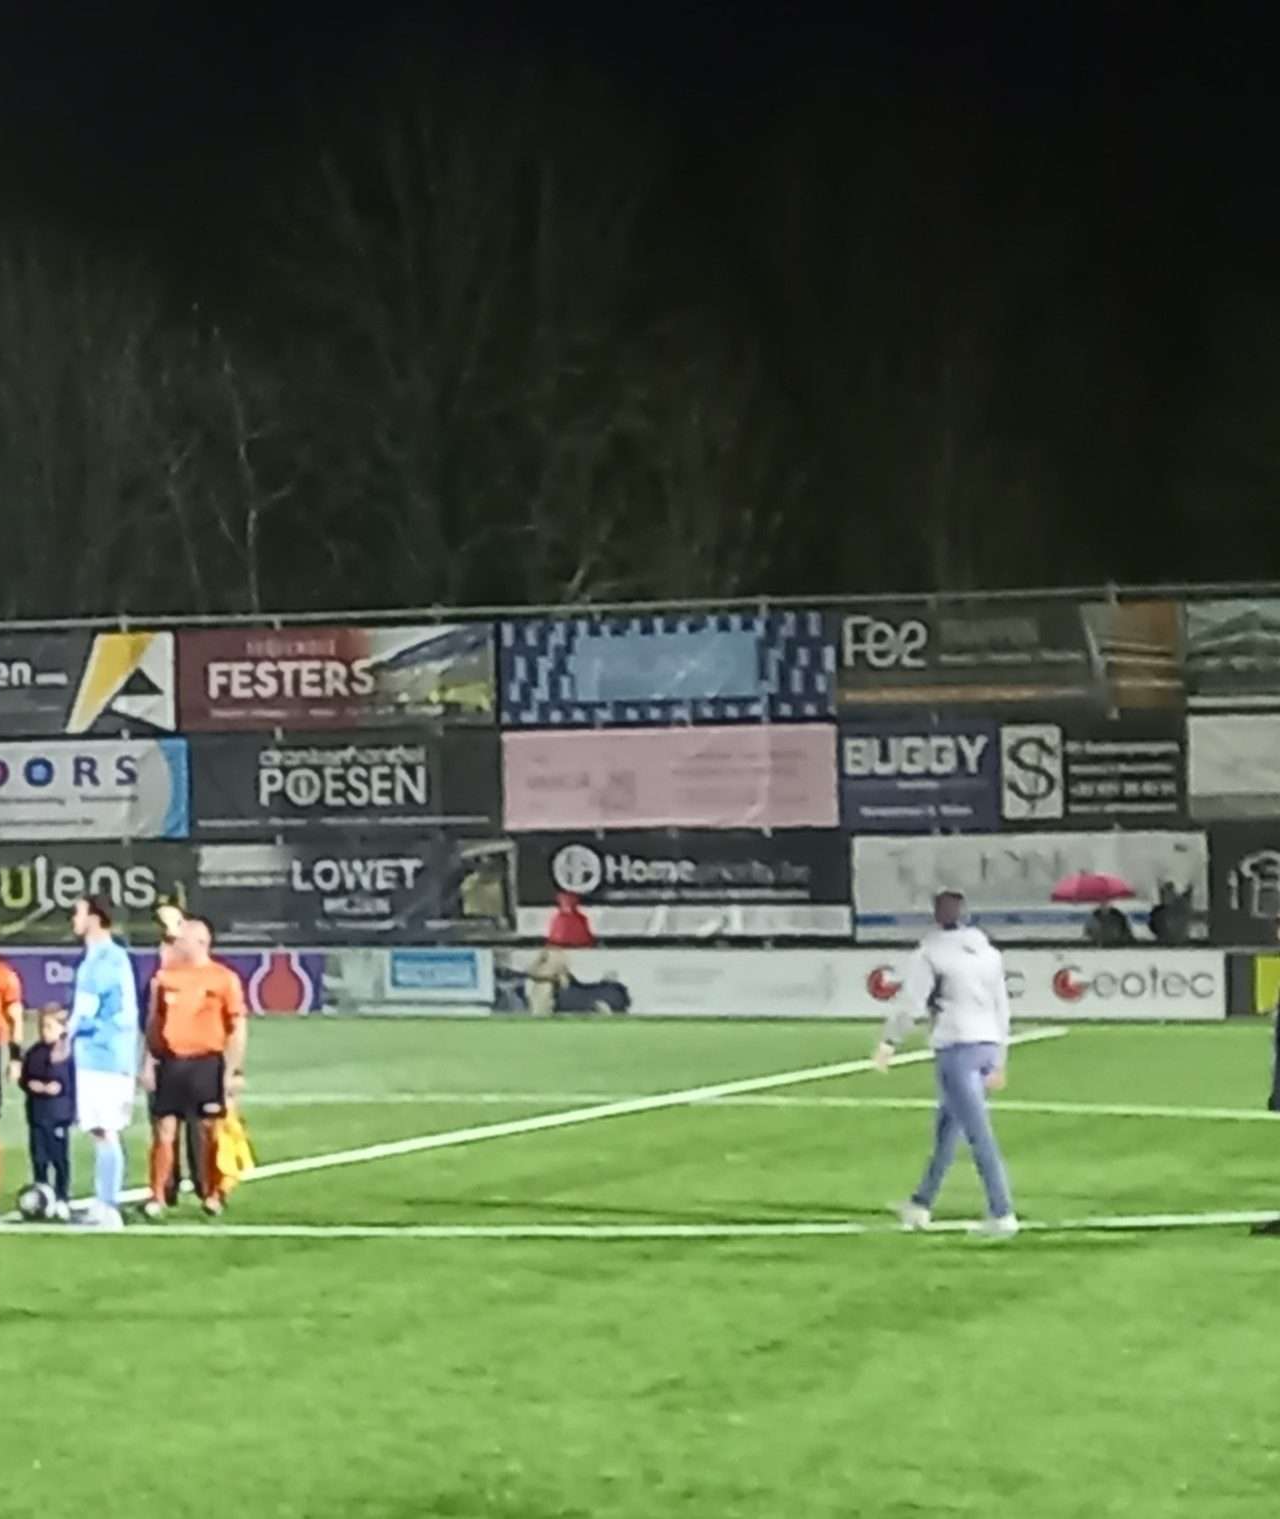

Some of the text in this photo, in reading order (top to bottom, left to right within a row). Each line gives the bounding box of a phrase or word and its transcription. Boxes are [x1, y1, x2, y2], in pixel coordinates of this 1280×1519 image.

[207, 659, 376, 699] FESTERS
[843, 735, 988, 776] BUGGY
[258, 764, 428, 807] POESEN
[291, 858, 424, 891] LOWET
